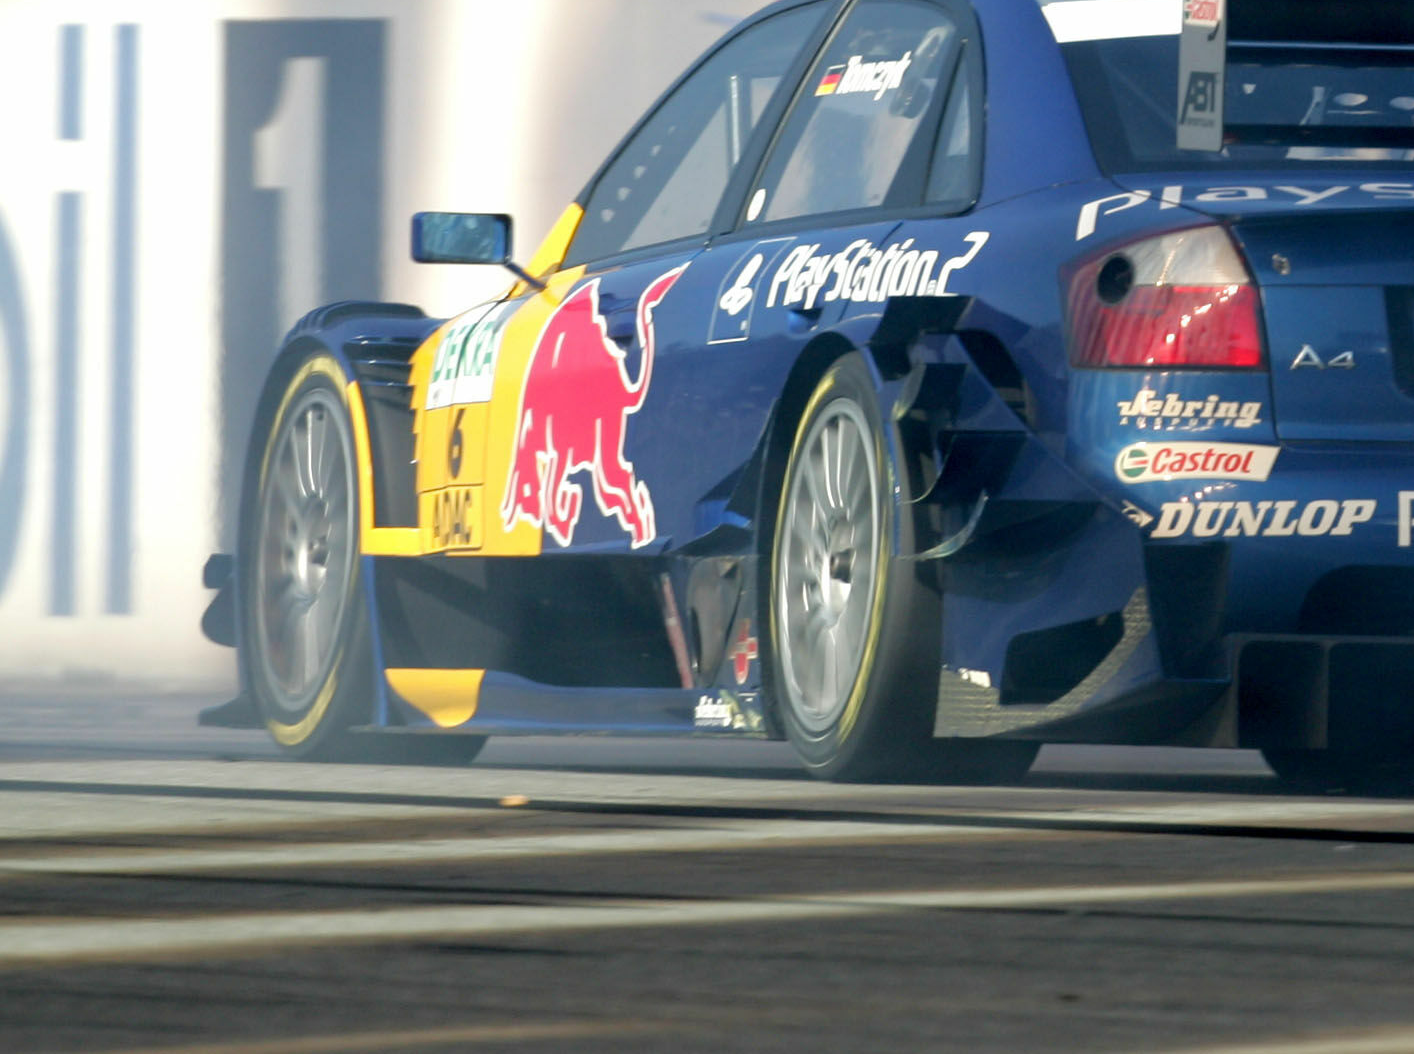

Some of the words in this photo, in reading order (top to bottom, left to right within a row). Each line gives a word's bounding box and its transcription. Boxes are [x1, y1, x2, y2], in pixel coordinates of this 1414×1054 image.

[1179, 71, 1217, 124] ABT
[1289, 343, 1356, 370] A4
[448, 407, 466, 481] 6
[1151, 447, 1256, 474] Castrol
[1150, 499, 1377, 538] DUNLOP
